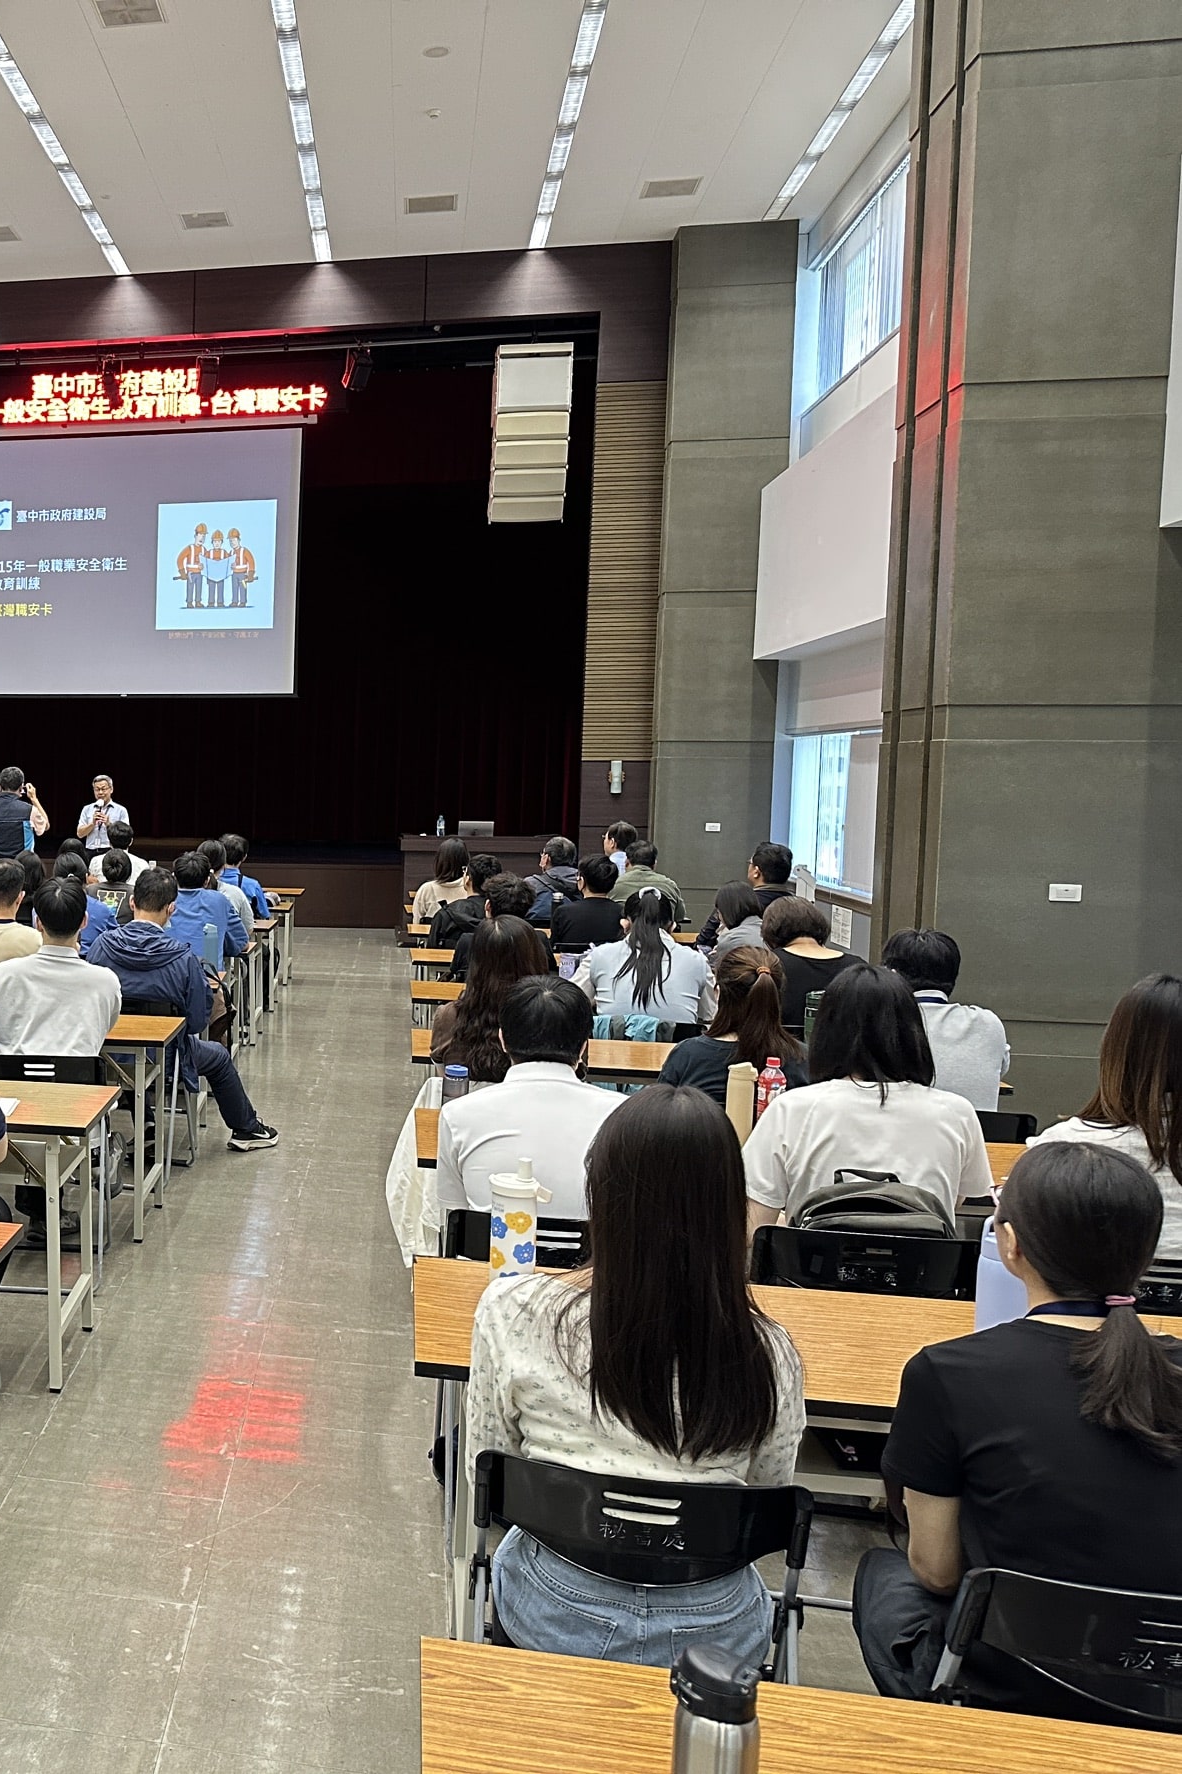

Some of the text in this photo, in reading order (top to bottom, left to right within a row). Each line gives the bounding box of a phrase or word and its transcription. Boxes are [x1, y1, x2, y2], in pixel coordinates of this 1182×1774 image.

[16, 507, 107, 522] 臺中市政府建設局
